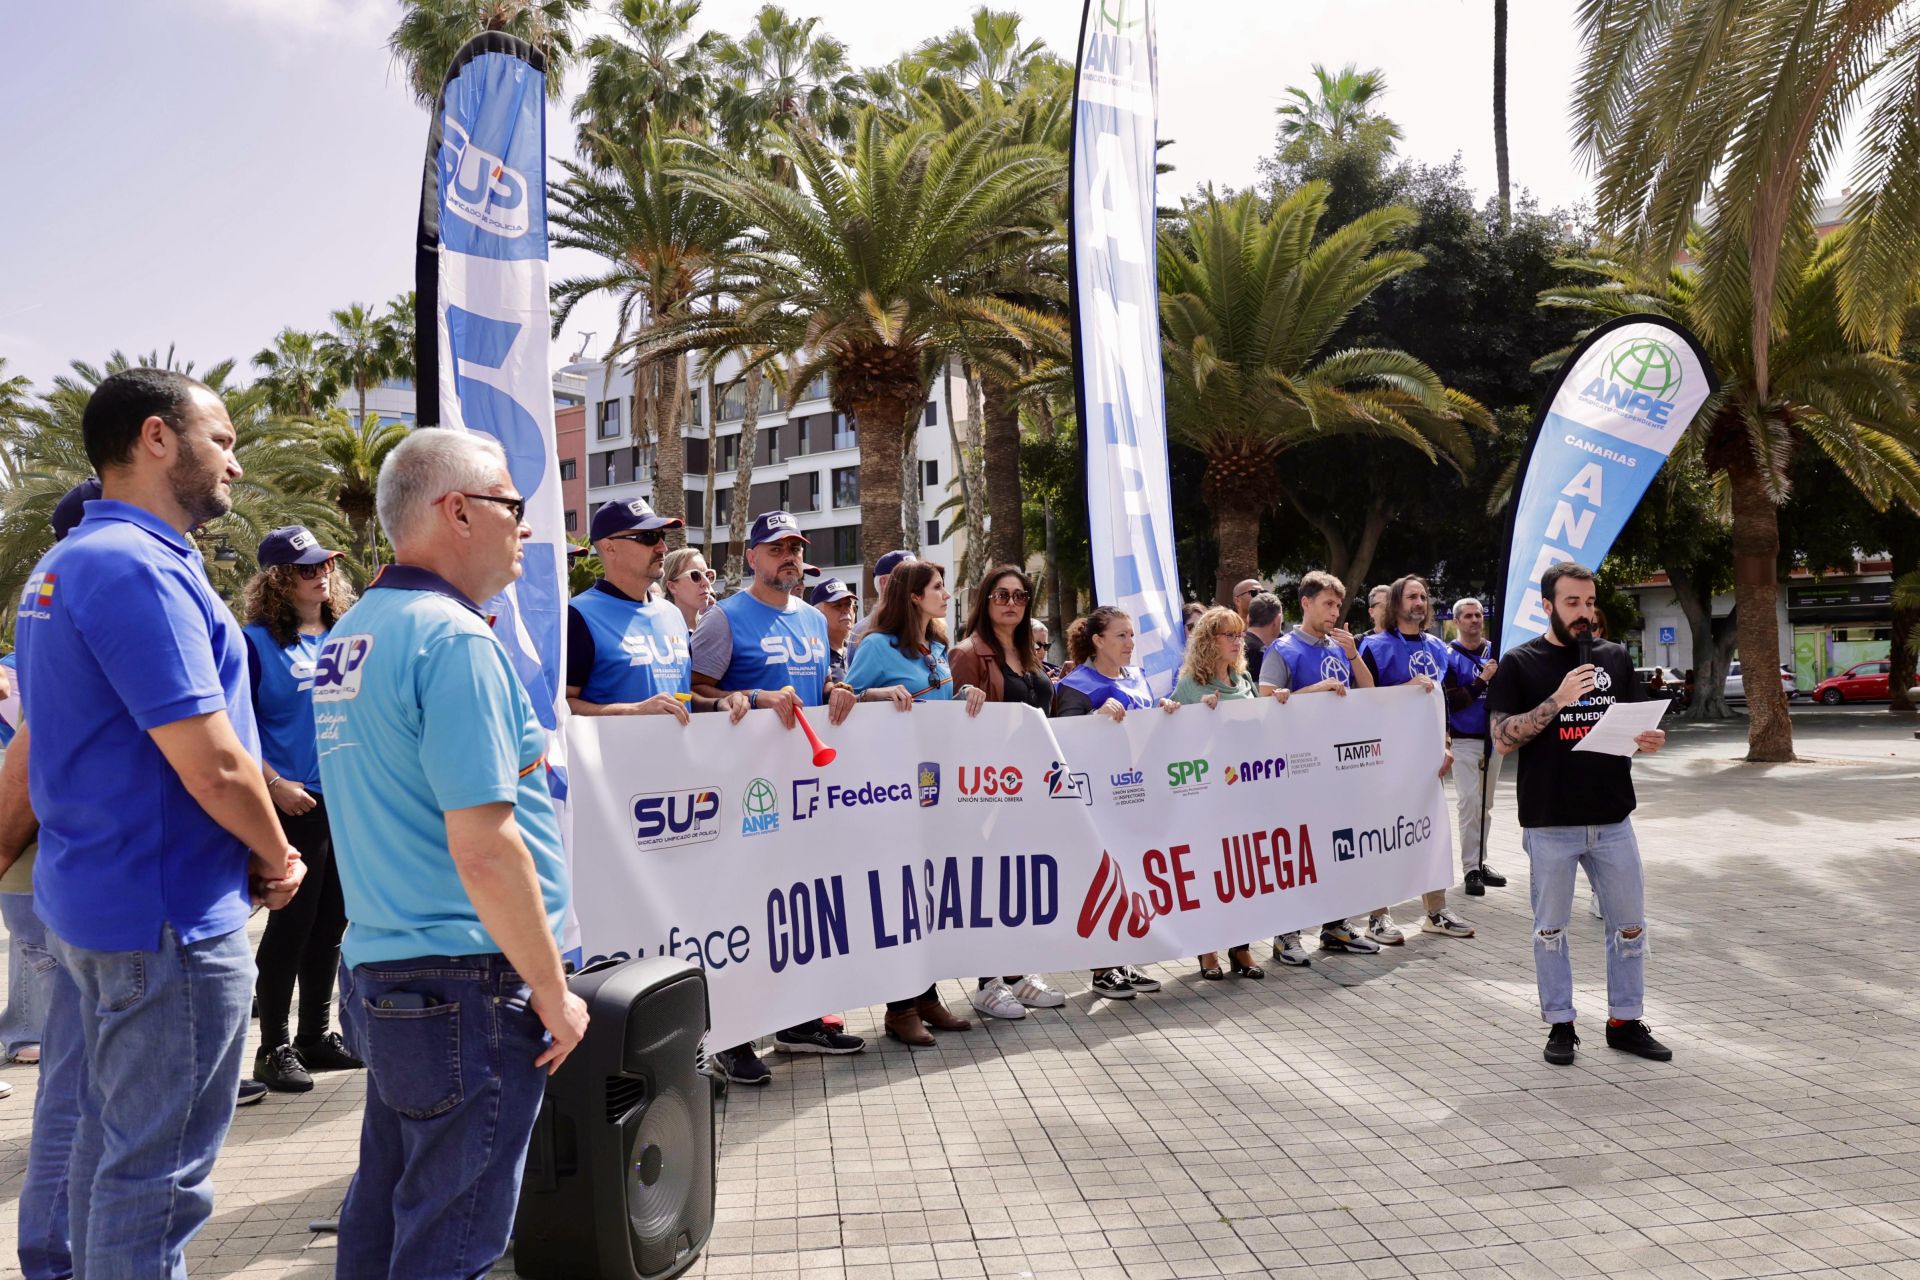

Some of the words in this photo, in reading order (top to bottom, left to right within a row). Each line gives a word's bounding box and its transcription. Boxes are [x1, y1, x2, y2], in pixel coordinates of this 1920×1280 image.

[1580, 376, 1675, 425] ANPE
[1564, 434, 1637, 468] CANARIAS
[313, 639, 367, 687] SUP
[622, 633, 690, 667] SUP
[760, 635, 826, 665] SUP
[1560, 713, 1574, 722] ME
[1333, 739, 1382, 762] TAMPM
[958, 766, 1024, 796] USO
[1167, 758, 1209, 787] SPP
[1240, 757, 1286, 782] APFP
[827, 781, 913, 809] Fedeca
[919, 786, 938, 800] UFP
[634, 791, 719, 839] SUP
[742, 812, 780, 833] ANPE
[637, 838, 664, 846] SINDICATO
[664, 834, 691, 842] UNIFICADO
[1359, 815, 1431, 858] muface
[767, 874, 850, 973] CON
[867, 864, 922, 950] LA
[923, 853, 1059, 934] SALUD
[1142, 844, 1201, 916] SE
[1213, 823, 1318, 904] JUEGA
[584, 925, 751, 973] face
